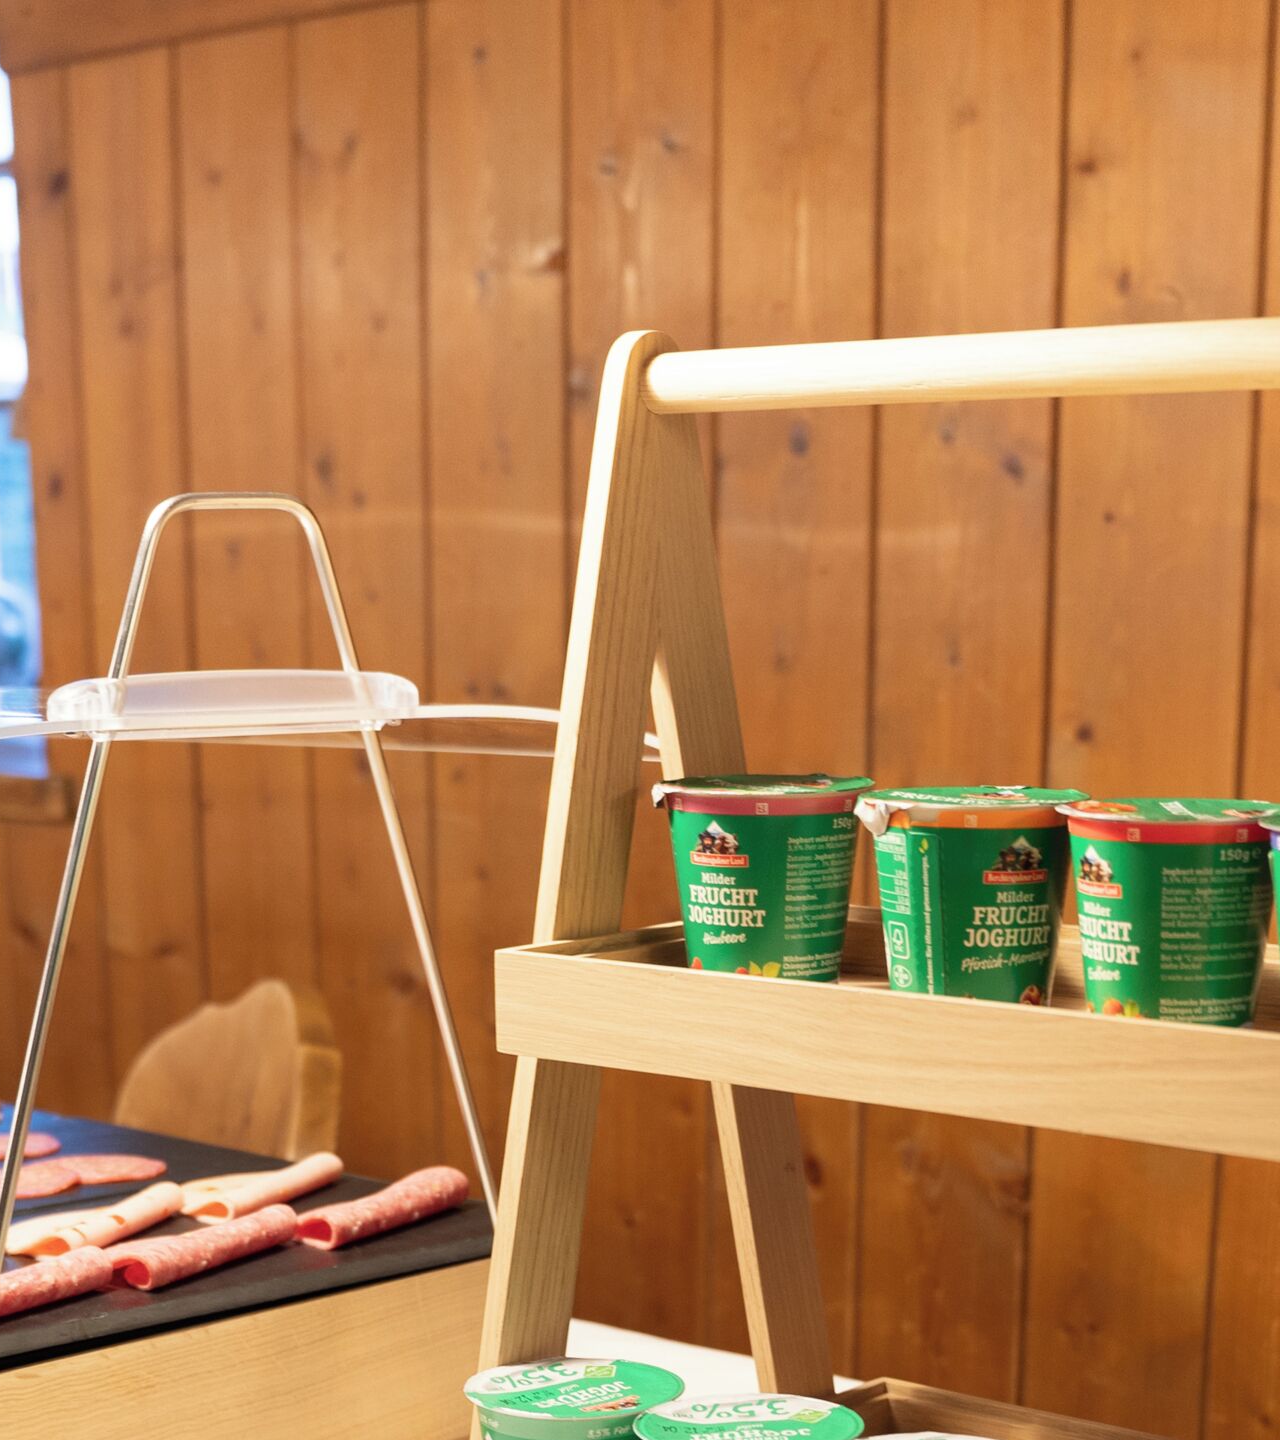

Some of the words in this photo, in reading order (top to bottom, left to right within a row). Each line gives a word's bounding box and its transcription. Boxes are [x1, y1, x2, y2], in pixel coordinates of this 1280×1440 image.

[1219, 849, 1250, 863] 150g
[700, 871, 737, 886] Milder
[688, 883, 759, 906] FRUCHT
[996, 890, 1036, 903] Milder
[688, 904, 767, 928] JOGHURT
[972, 904, 1050, 926] FRUCHT
[963, 925, 1052, 948] JOGHURT
[489, 1362, 578, 1390] 3,5%
[532, 1381, 633, 1409] JOGHURT
[690, 1398, 789, 1419] 3,5%
